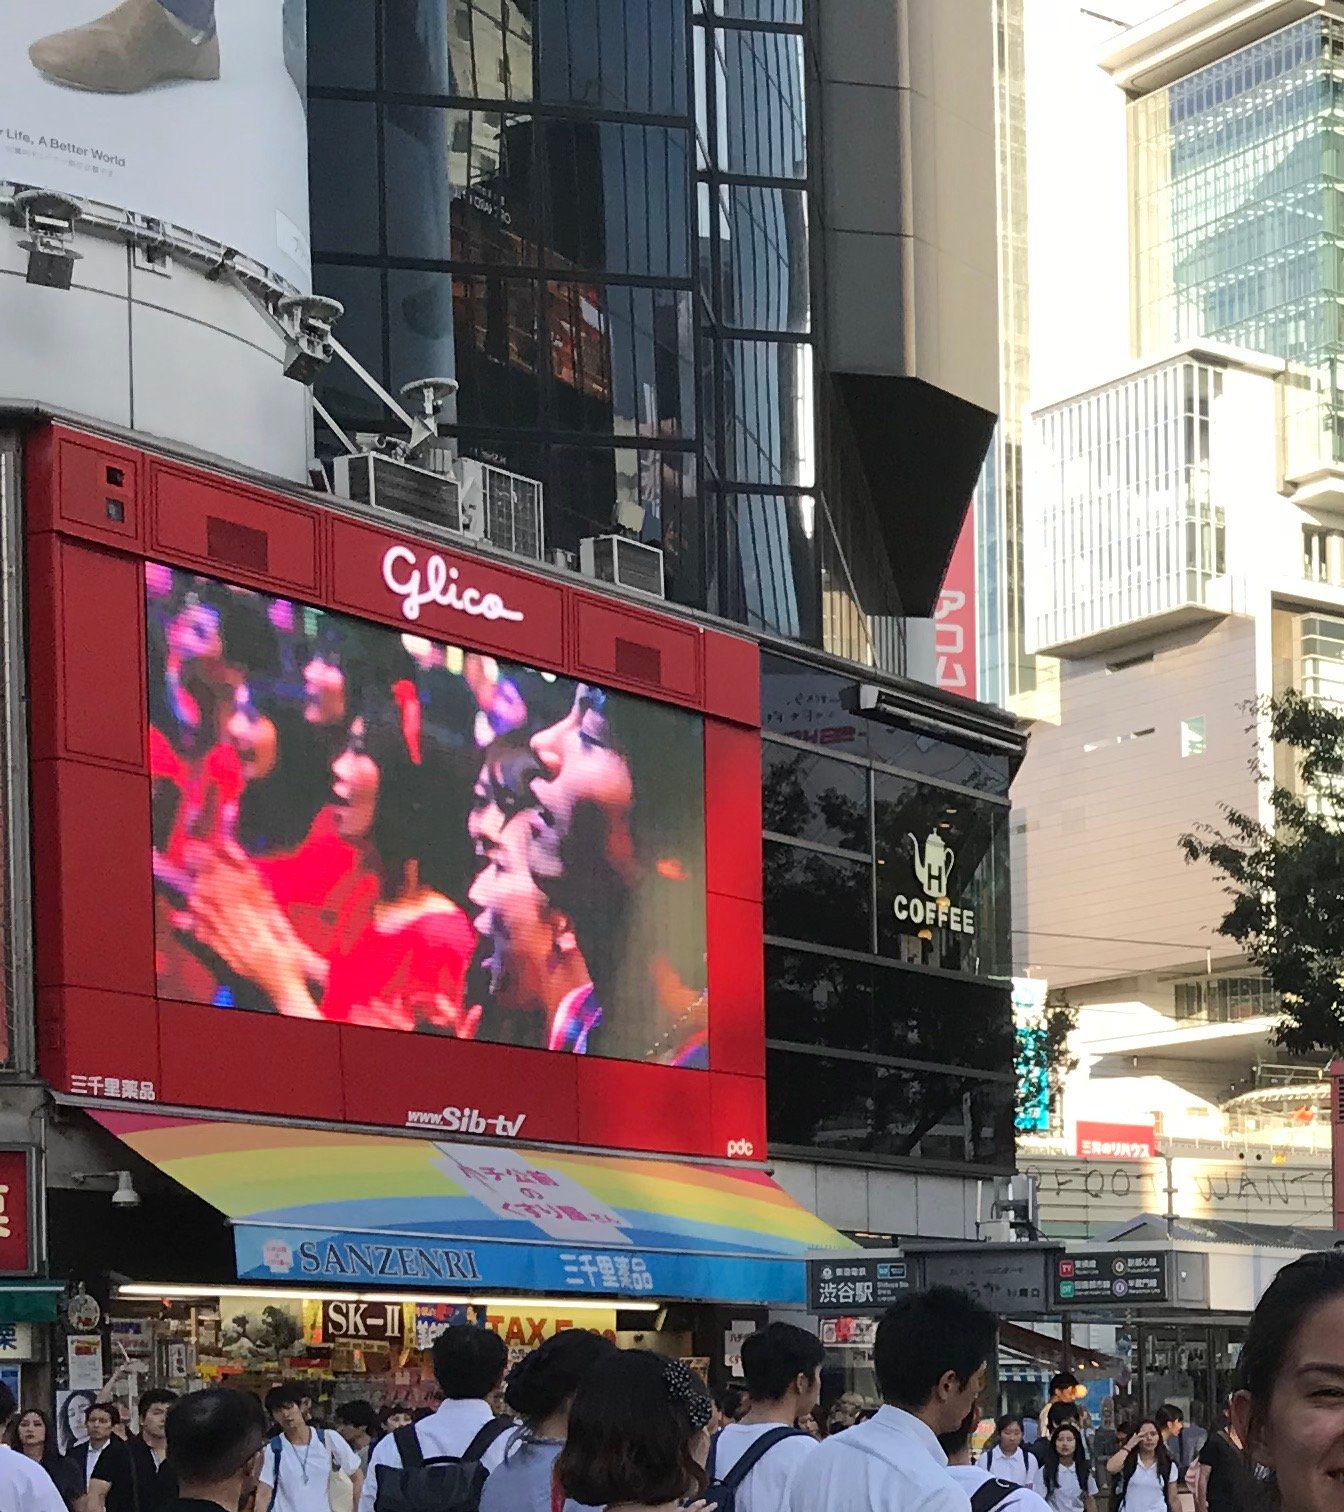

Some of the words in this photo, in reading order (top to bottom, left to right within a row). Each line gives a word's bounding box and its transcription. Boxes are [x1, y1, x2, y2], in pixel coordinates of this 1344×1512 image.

[6, 128, 35, 146] Life,
[38, 135, 48, 147] A
[50, 138, 88, 156] Better
[91, 148, 126, 167] World
[382, 545, 524, 621] Glico
[893, 894, 975, 934] COFFEE
[70, 1074, 156, 1101] 三千里薬品
[727, 1138, 754, 1157] pdc
[299, 1240, 482, 1281] SANZENRI
[559, 1252, 654, 1291] 三千里薬品
[819, 1282, 874, 1304] 渋谷駅
[486, 1315, 547, 1346] TAX
